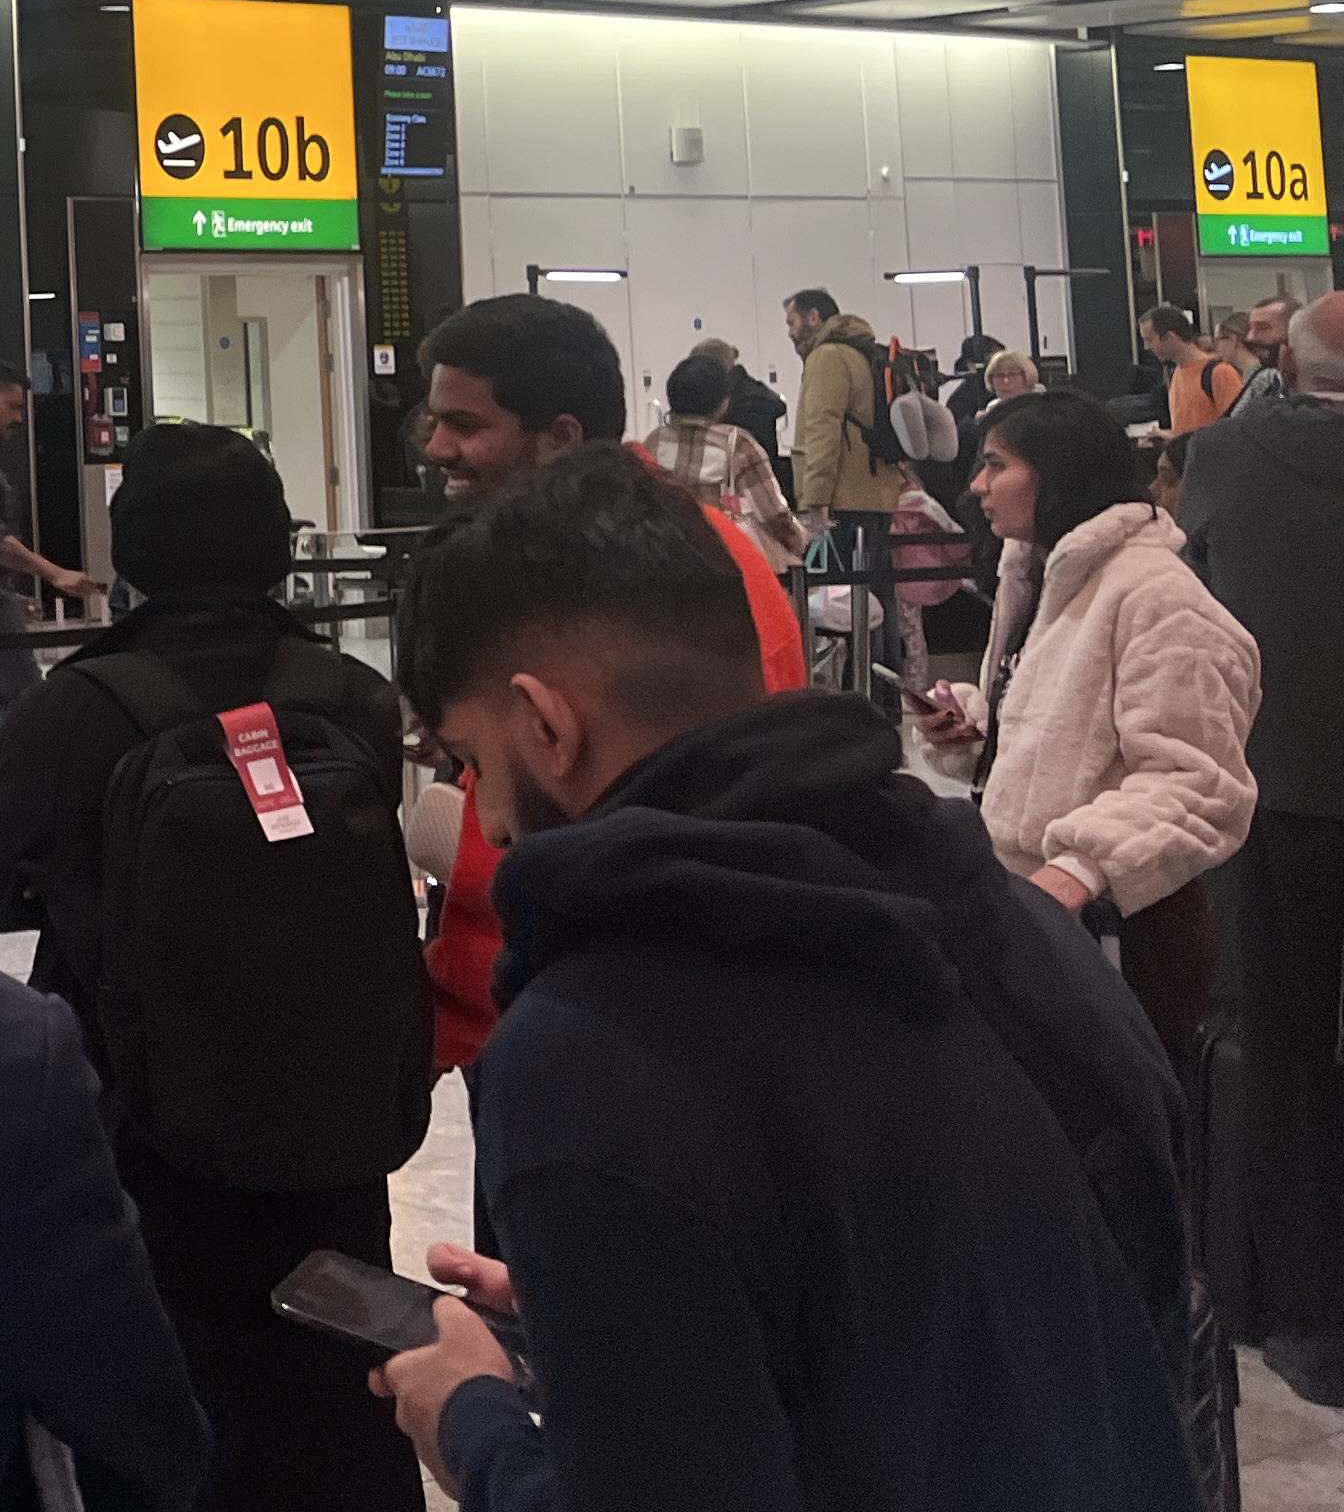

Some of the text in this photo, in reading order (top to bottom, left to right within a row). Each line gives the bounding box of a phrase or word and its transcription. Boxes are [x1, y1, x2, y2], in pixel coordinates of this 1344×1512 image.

[220, 116, 330, 182] 10b
[1243, 150, 1308, 201] 10a
[227, 217, 313, 236] Emergency exit
